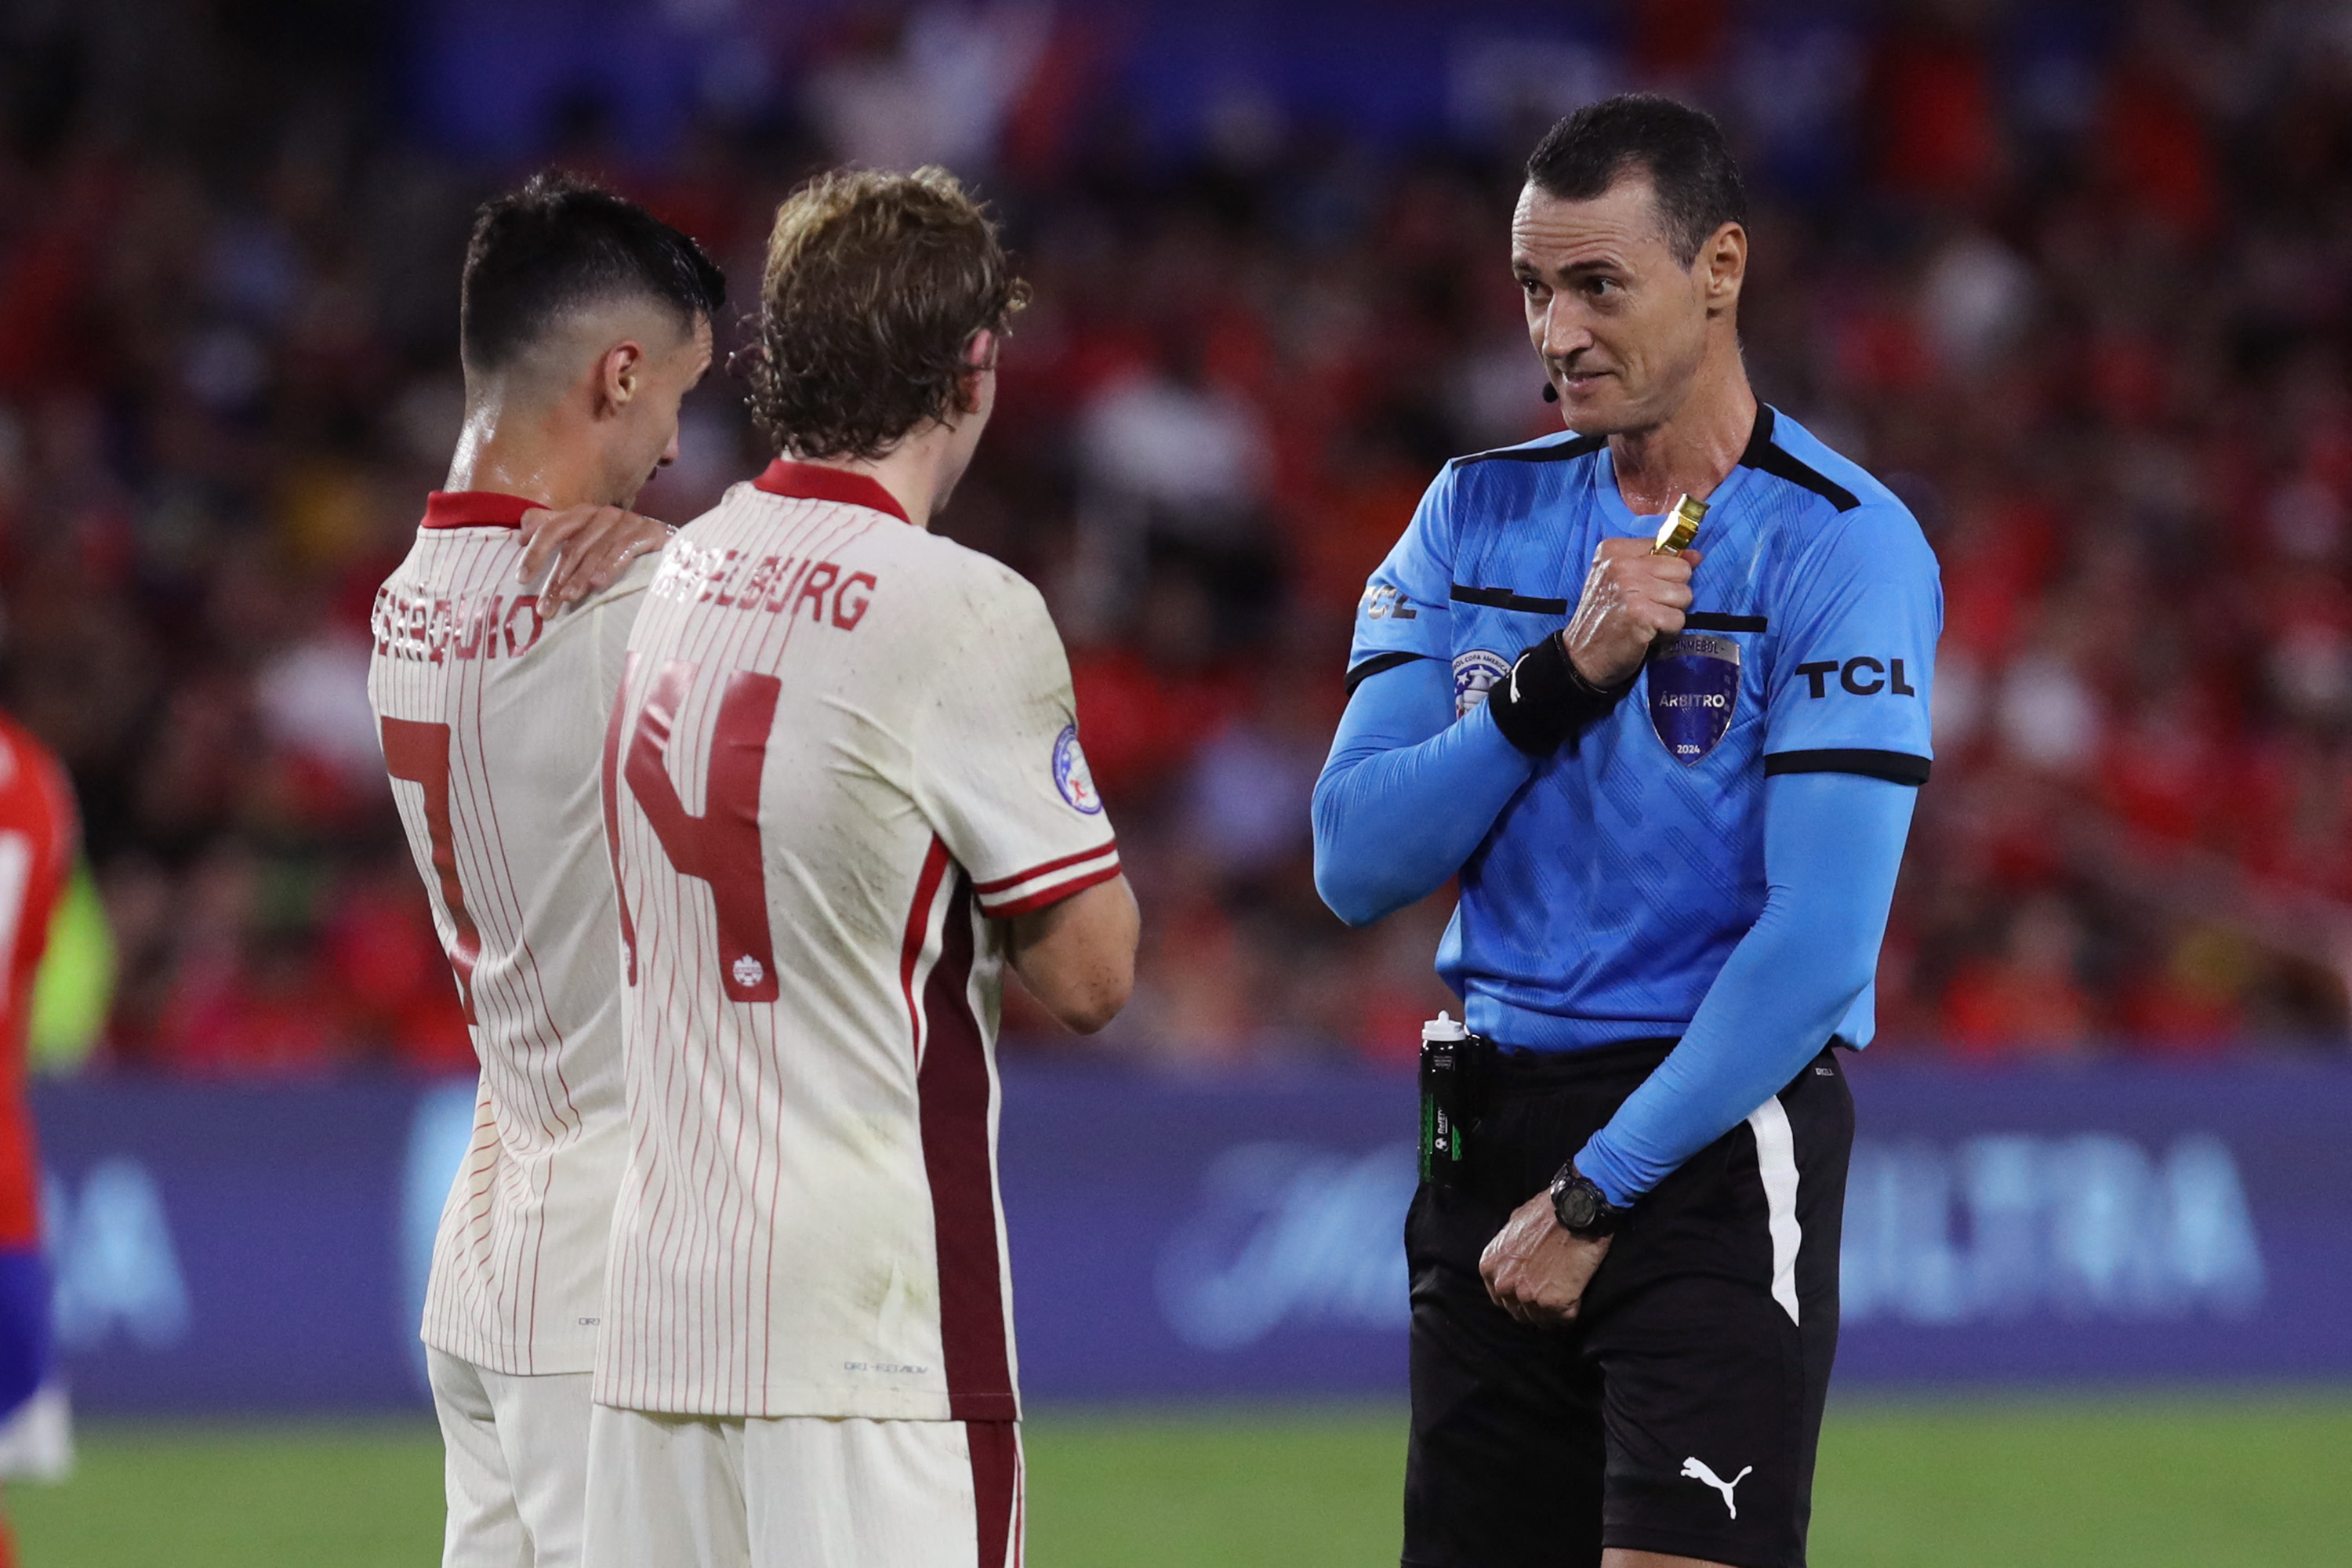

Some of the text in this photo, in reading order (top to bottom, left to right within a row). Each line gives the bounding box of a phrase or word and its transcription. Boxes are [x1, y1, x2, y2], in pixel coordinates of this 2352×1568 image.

[1465, 654, 1481, 662] COPA
[1795, 656, 1915, 699] TCL
[1659, 691, 1725, 708] ÁRBITRO
[1676, 745, 1700, 754] 2024
[380, 715, 481, 1026] 7
